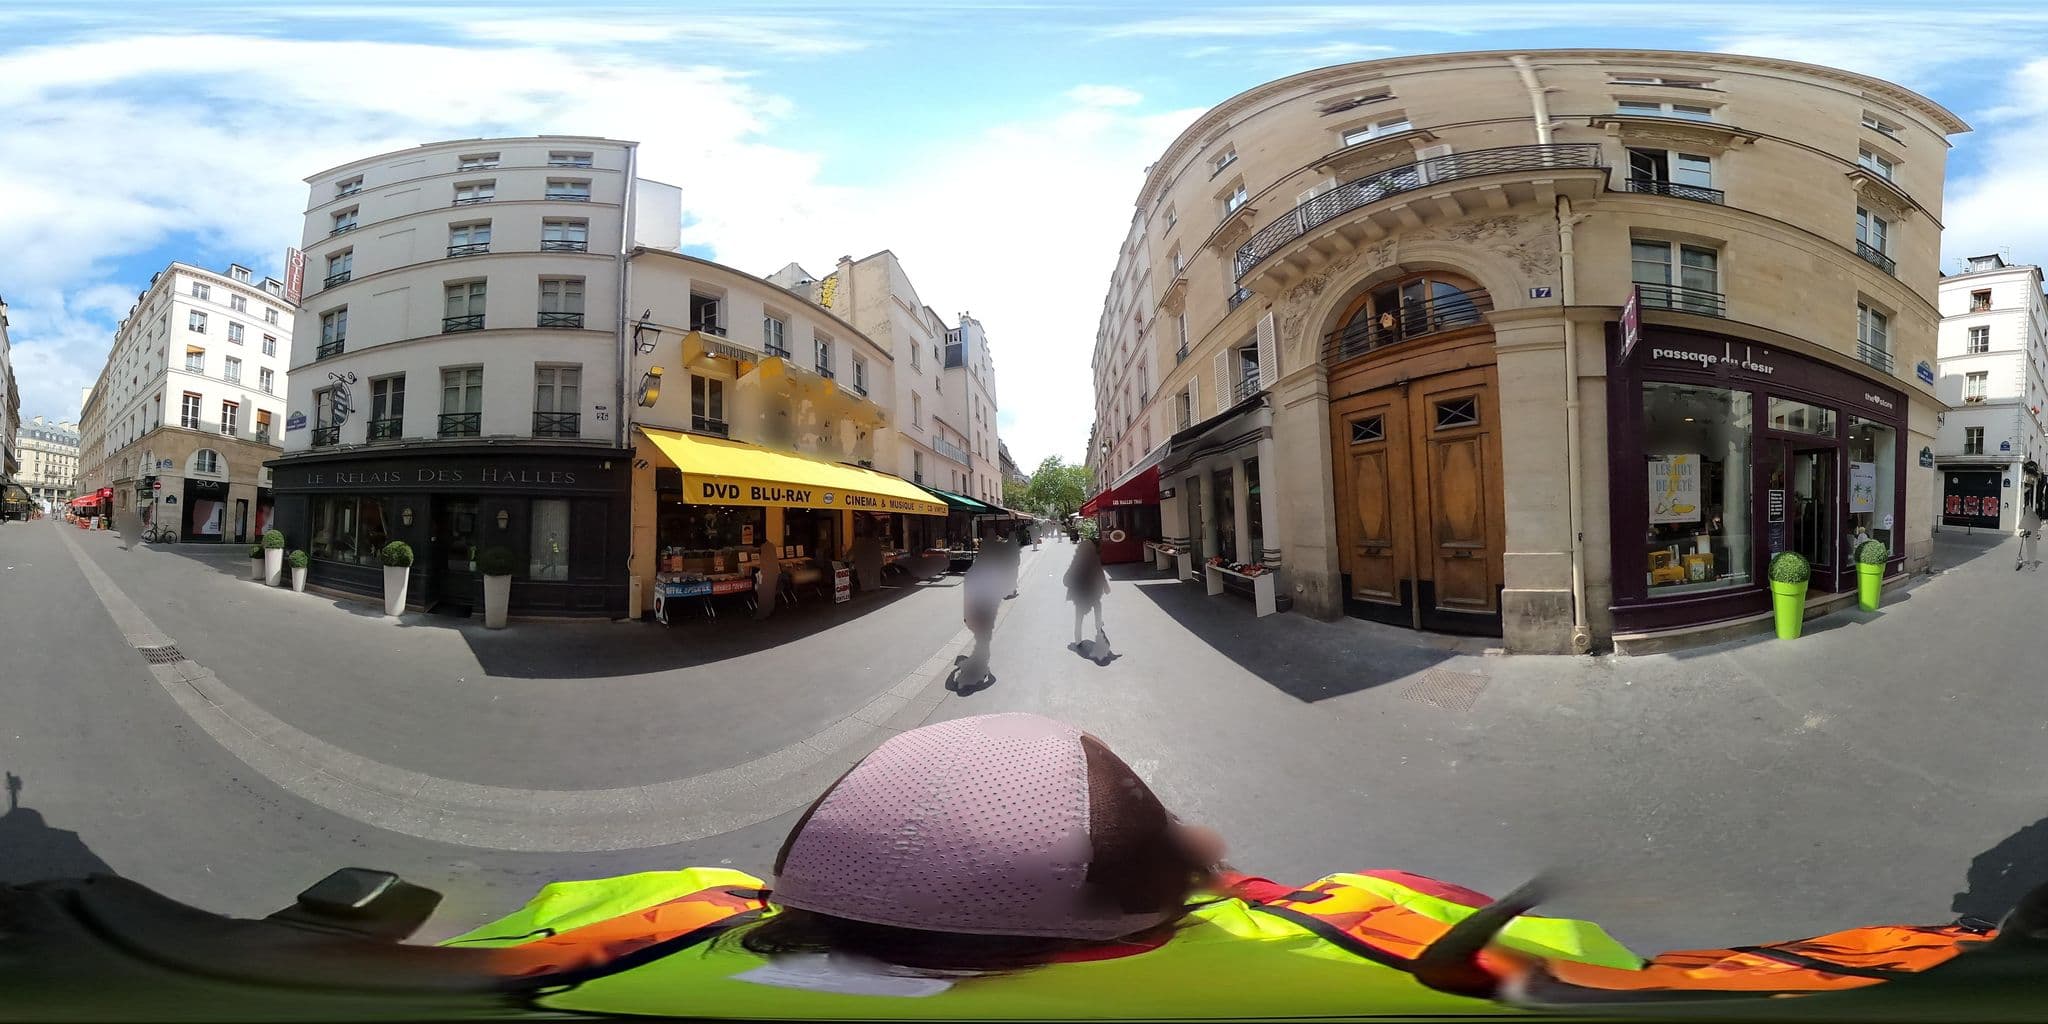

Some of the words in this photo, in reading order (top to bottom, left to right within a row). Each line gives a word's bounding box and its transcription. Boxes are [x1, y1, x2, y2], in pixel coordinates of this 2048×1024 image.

[291, 249, 304, 291] HOTEL
[1531, 287, 1549, 298] 17
[1653, 348, 1717, 368] passage
[306, 472, 324, 484] LE
[335, 471, 401, 483] RELAIS
[417, 468, 464, 481] DES
[481, 467, 577, 484] HALLES
[703, 482, 740, 499] DVD
[750, 486, 812, 502] BLU-RAY
[845, 494, 877, 507] CINEMA
[881, 499, 886, 508] &
[889, 500, 915, 511] MUSIQUE
